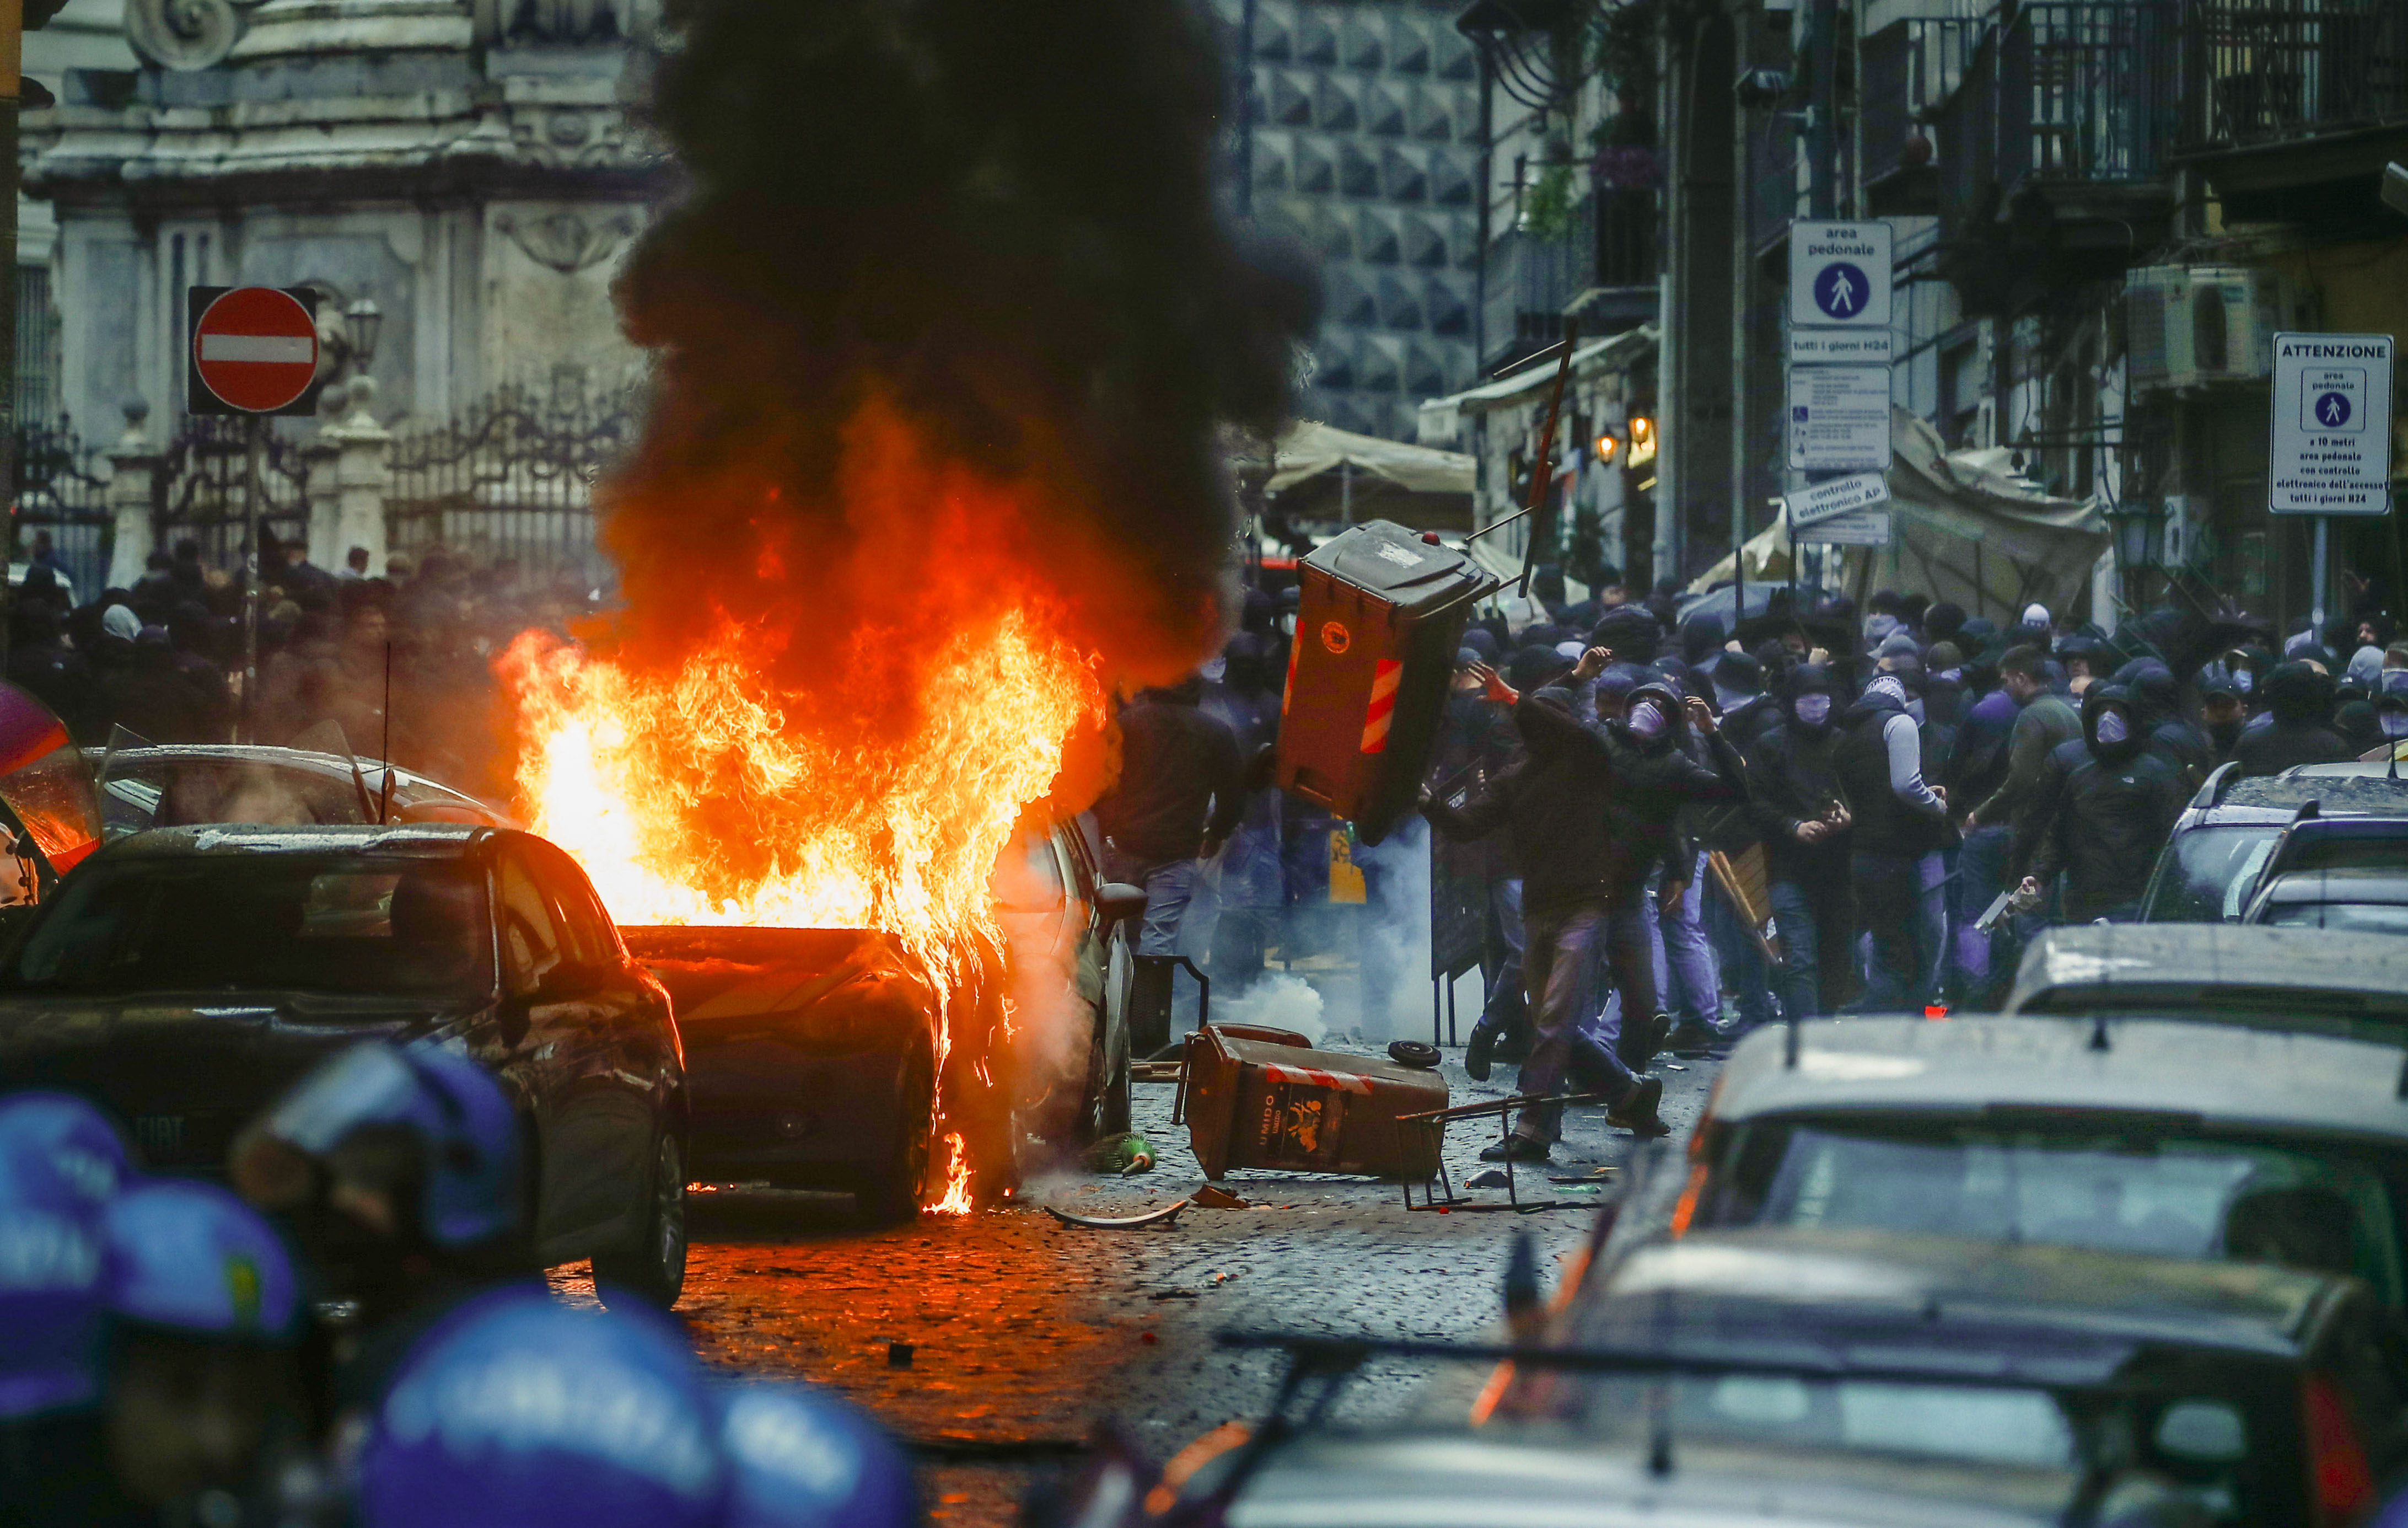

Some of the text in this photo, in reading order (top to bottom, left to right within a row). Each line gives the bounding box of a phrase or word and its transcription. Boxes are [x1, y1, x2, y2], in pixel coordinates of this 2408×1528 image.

[1826, 228, 1857, 238] area
[1808, 243, 1874, 255] pedonale
[1793, 340, 1888, 352] tutti i giorni H24
[2283, 344, 2386, 358] ATTENZIONE
[2312, 381, 2355, 390] pedonale
[2318, 437, 2328, 446] 10
[2331, 437, 2355, 447] metri
[2300, 452, 2361, 463] area pedonale
[2319, 466, 2360, 475] controllo
[2277, 478, 2326, 489] elettronico
[1810, 480, 1862, 501] controllo
[1799, 487, 1880, 518] elettronico AP
[2291, 494, 2311, 503] tutti
[2320, 494, 2345, 505] giorni
[2348, 494, 2366, 503] H24
[1259, 1095, 1274, 1146] UMIDO
[136, 1117, 185, 1150] FIAT
